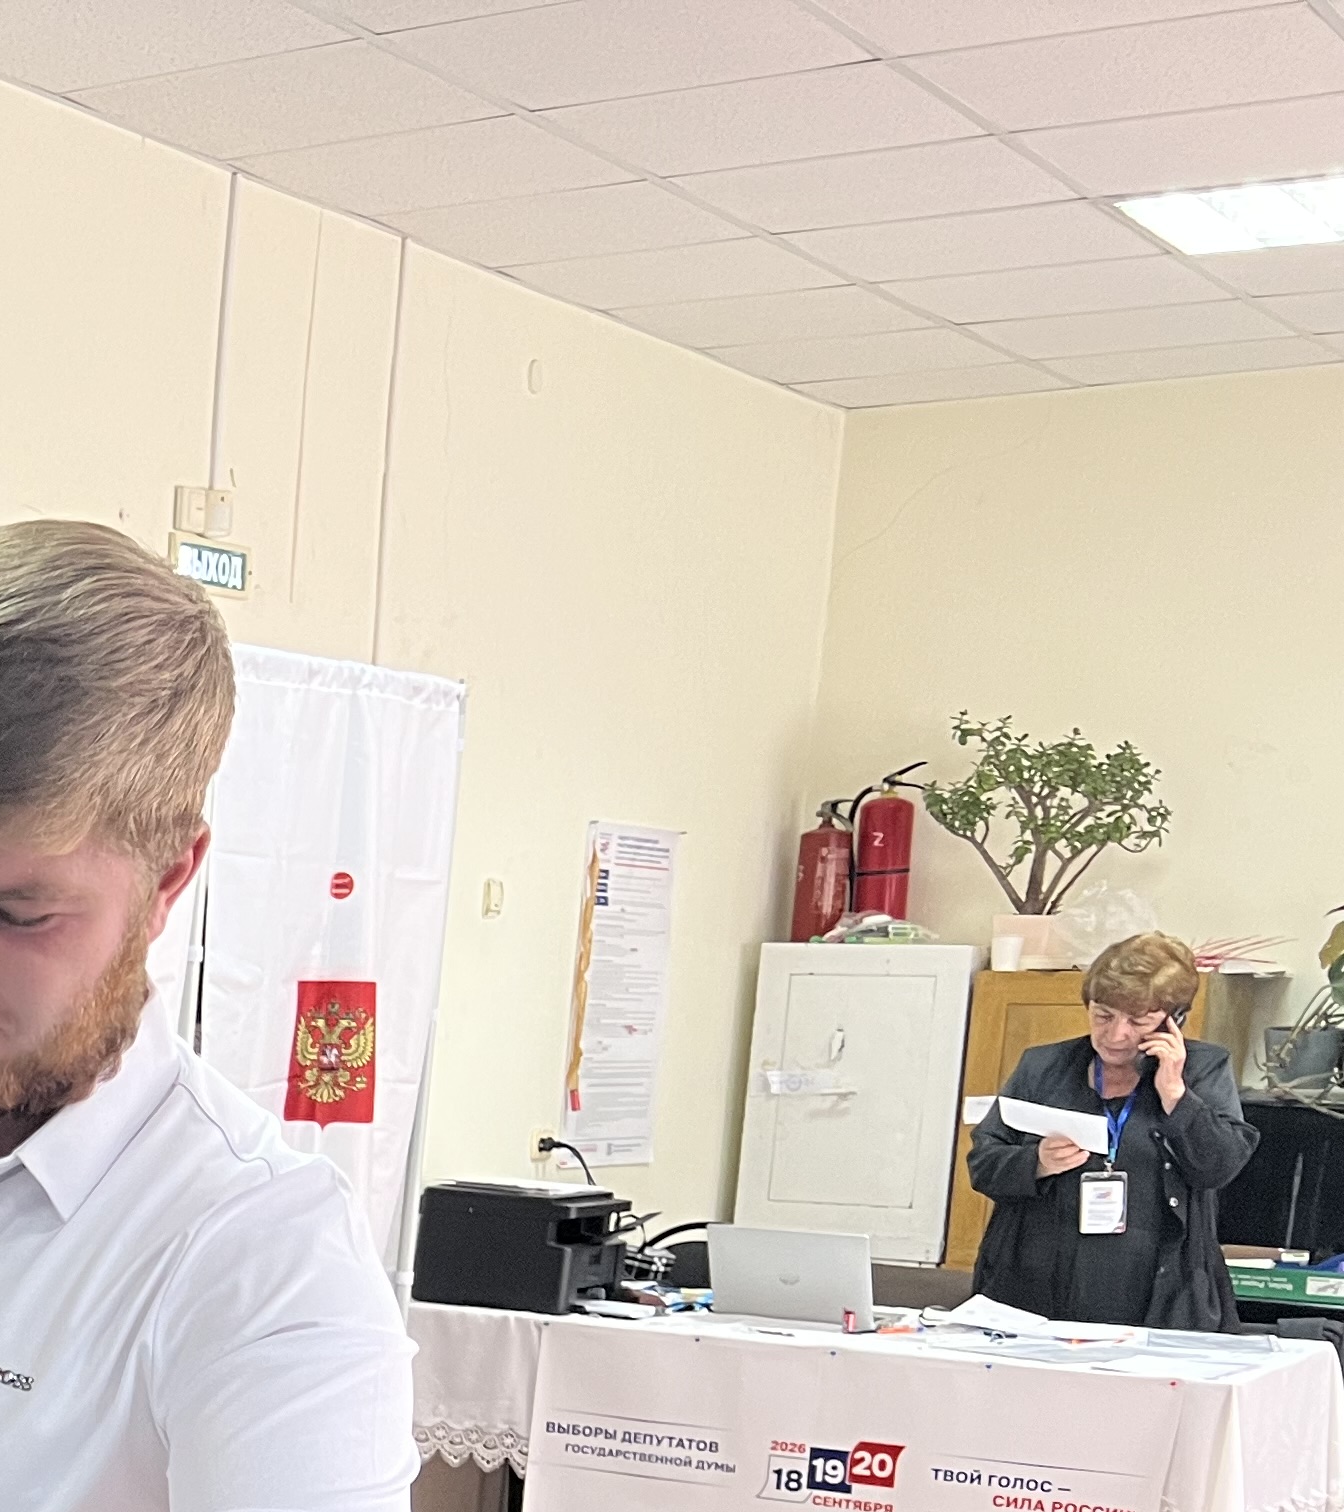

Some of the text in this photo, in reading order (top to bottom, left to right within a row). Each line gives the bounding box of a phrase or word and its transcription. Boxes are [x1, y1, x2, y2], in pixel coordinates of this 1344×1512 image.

[545, 1421, 719, 1453] ВЫБОРЫ ДЕПУТАТОВ
[770, 1440, 806, 1454] 2026
[565, 1443, 736, 1473] ГОСУДАРСТВЕННОЙ ДУМЫ
[812, 1457, 845, 1485] 19
[851, 1450, 894, 1478] 20
[772, 1468, 803, 1492] 18
[931, 1467, 982, 1485] ТВОЙ
[987, 1474, 1053, 1493] ГОЛОС
[992, 1495, 1045, 1512] СИЛА
